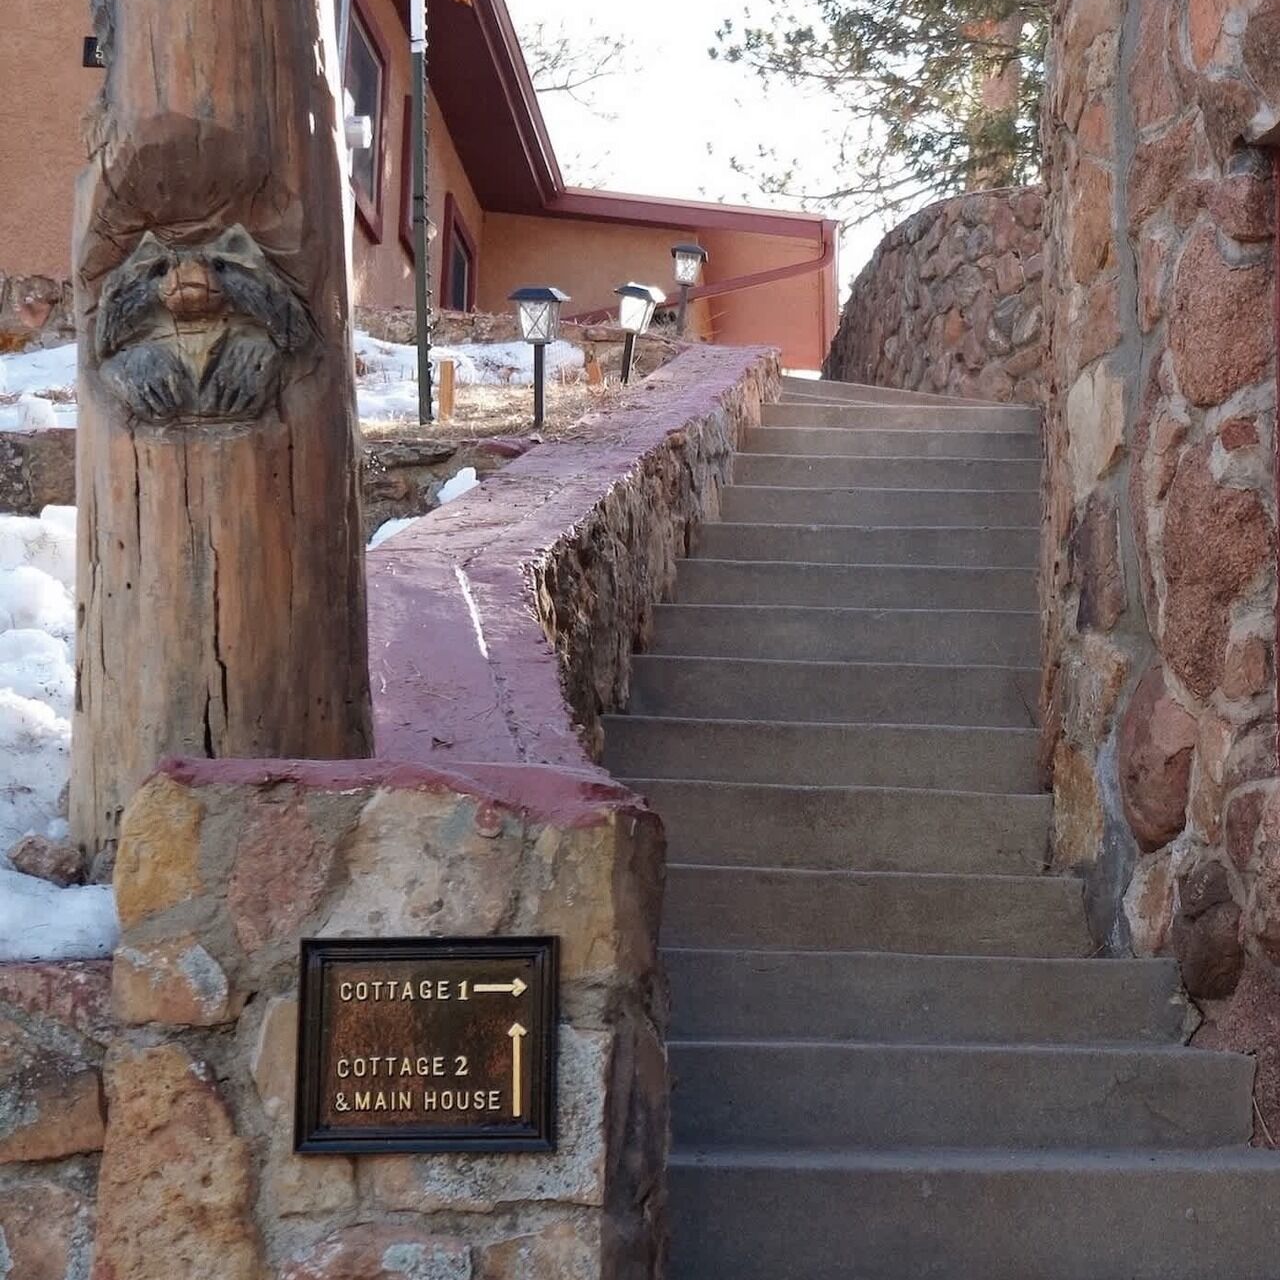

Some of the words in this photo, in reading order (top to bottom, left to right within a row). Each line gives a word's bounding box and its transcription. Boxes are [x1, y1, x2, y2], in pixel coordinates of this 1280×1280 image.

[339, 980, 451, 1001] COTTAGE
[457, 980, 470, 1001] 1
[336, 1057, 446, 1078] COTTAGE
[453, 1056, 470, 1076] 2
[424, 1090, 502, 1111] HOUSE
